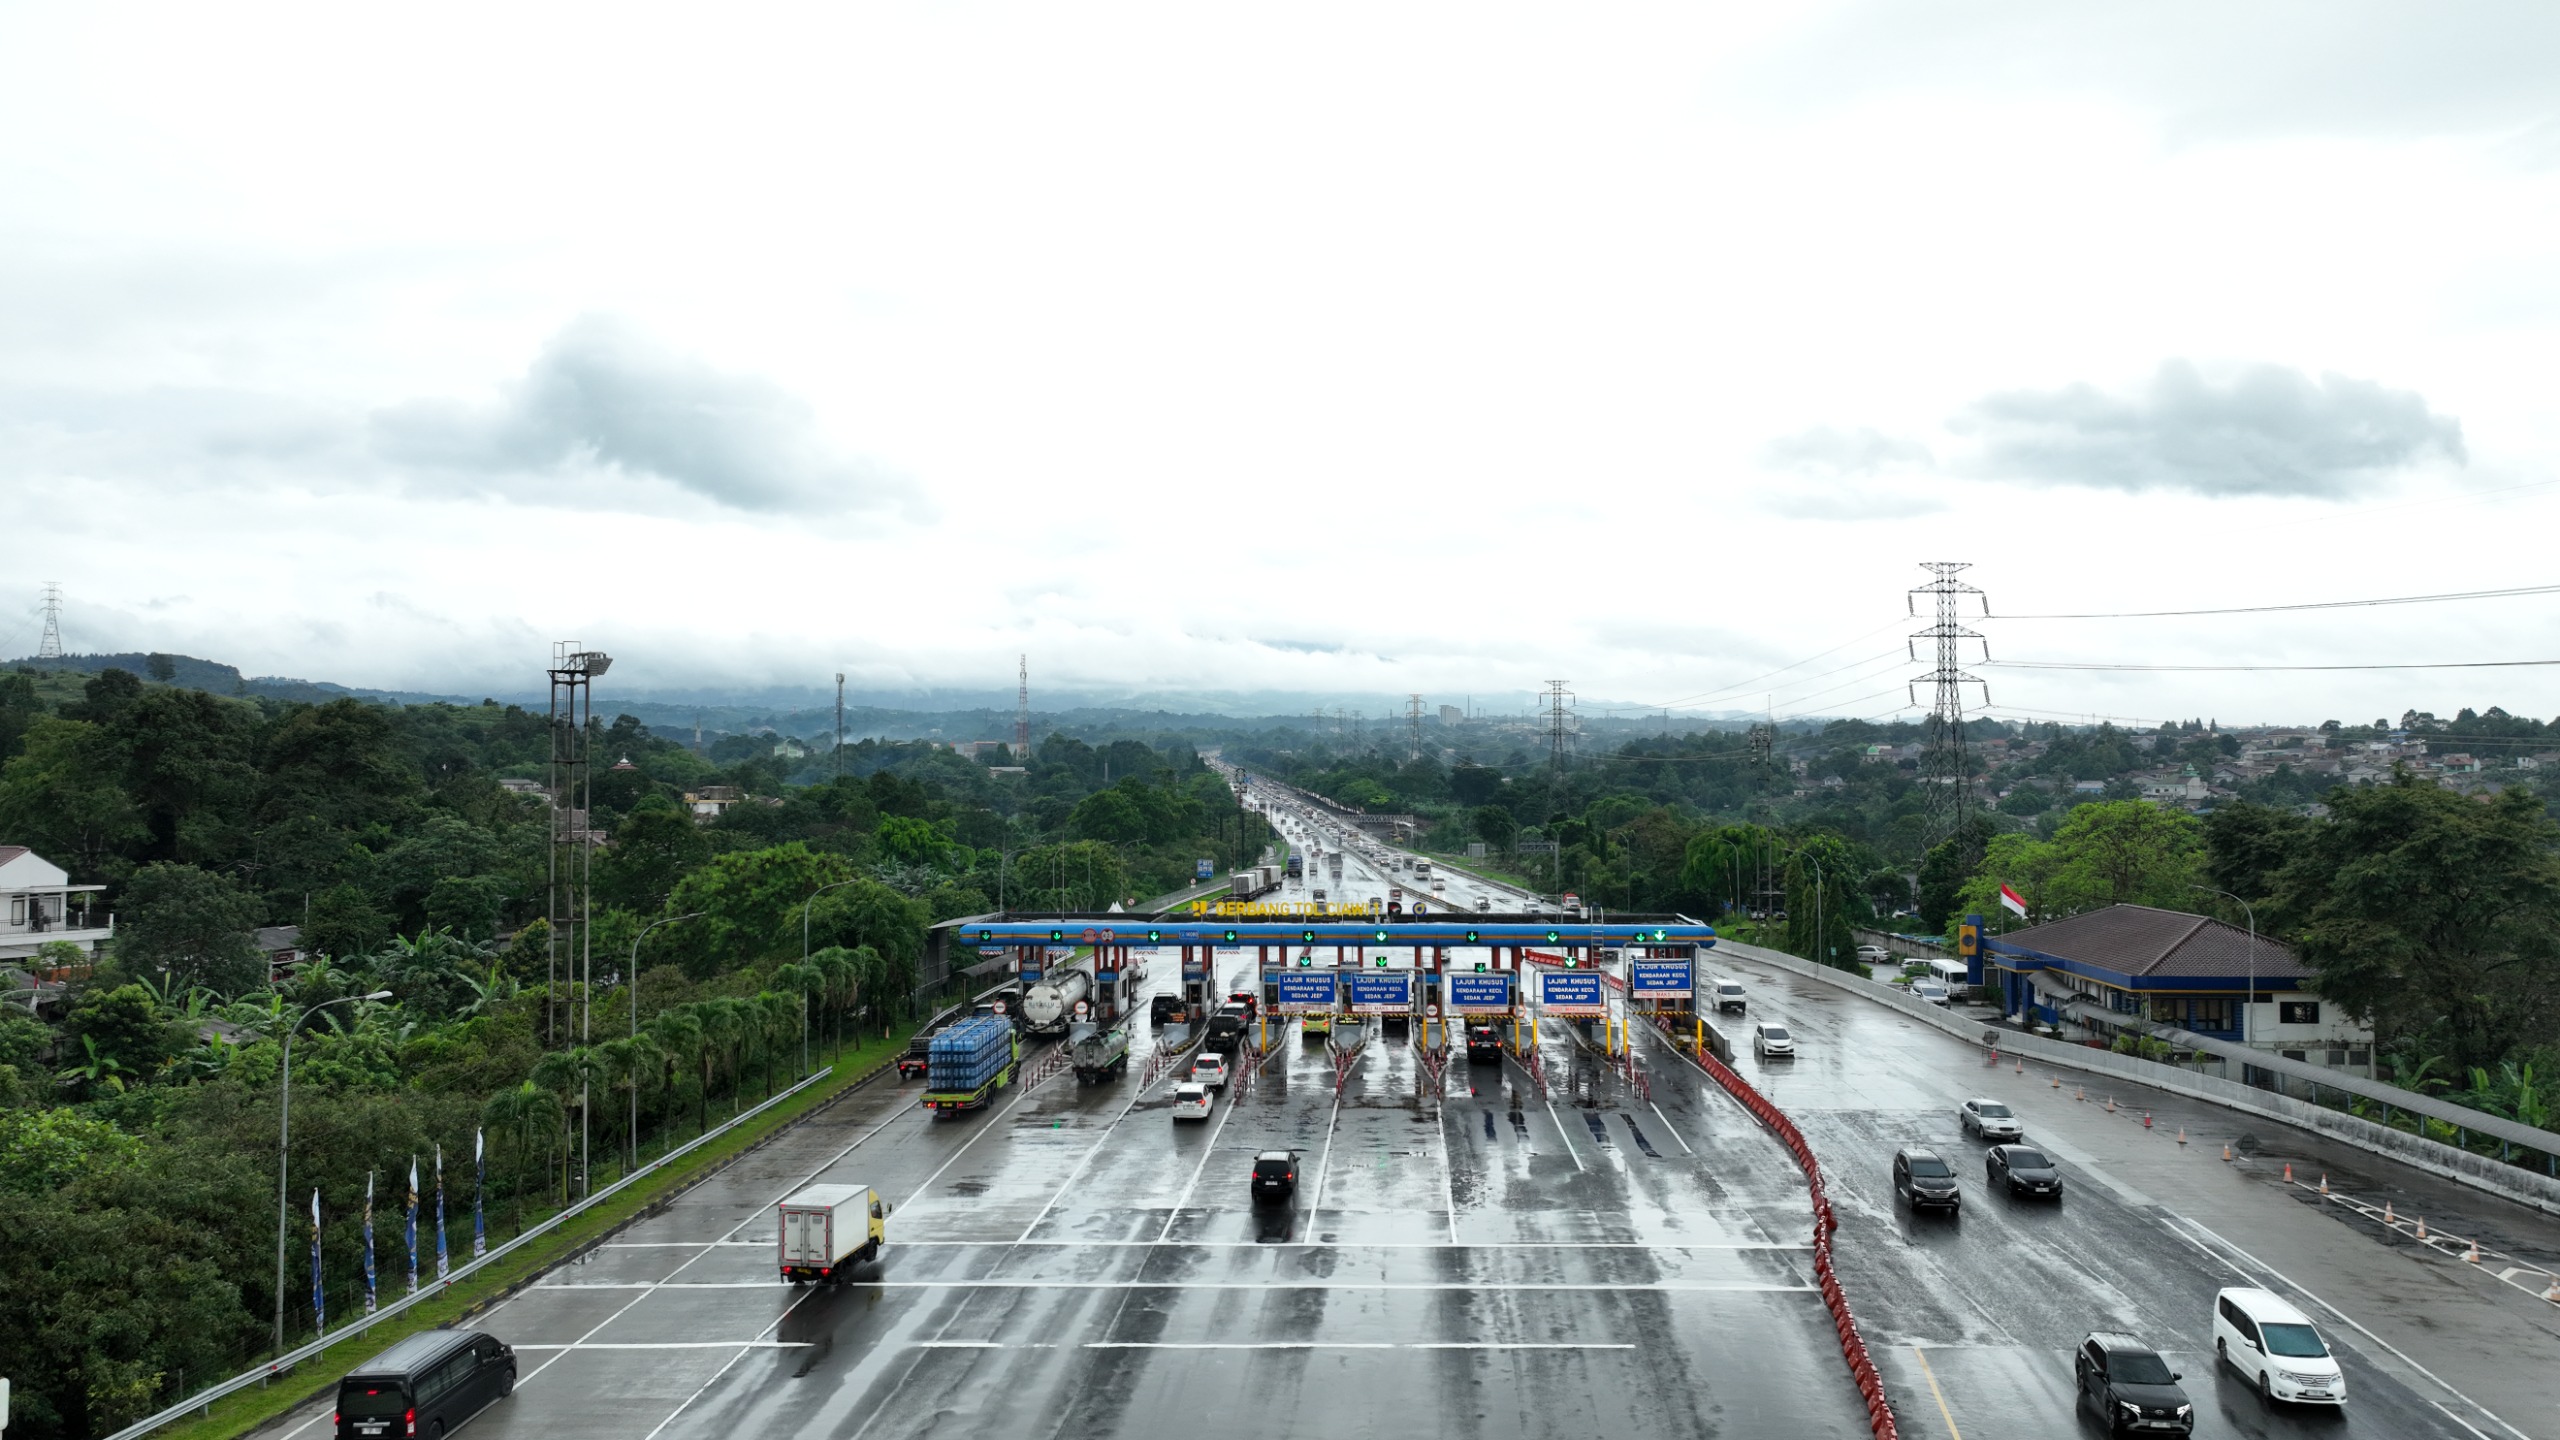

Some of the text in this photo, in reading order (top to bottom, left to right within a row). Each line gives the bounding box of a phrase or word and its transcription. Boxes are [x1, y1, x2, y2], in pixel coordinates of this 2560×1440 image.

[1215, 901, 1379, 916] GERBANG TOL CIAWI 1
